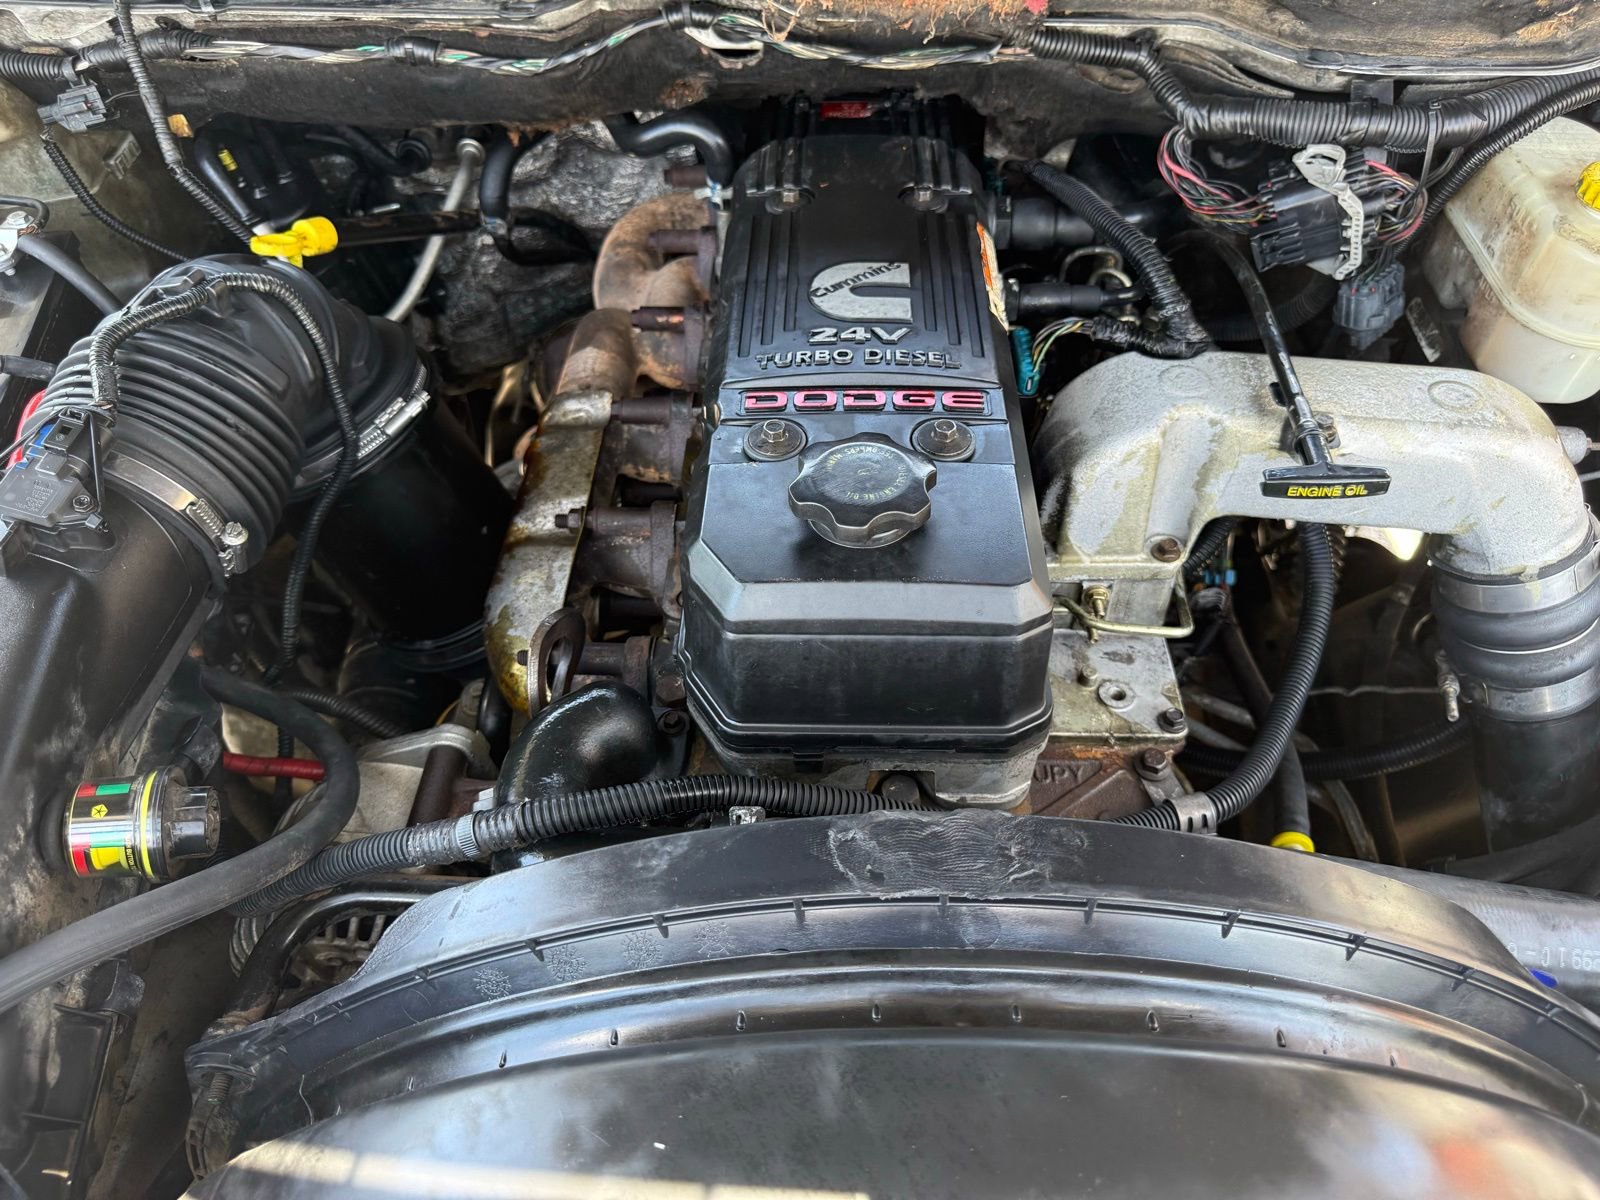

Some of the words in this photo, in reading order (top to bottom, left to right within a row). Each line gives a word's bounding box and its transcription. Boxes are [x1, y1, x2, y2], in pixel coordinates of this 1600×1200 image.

[810, 261, 901, 298] Cummins
[808, 327, 912, 346] 24V
[756, 349, 854, 369] TURBO
[864, 348, 961, 369] DIESEL
[744, 390, 985, 412] DODGE
[1287, 485, 1343, 497] ENGINE
[1345, 484, 1368, 496] OIL
[126, 848, 135, 865] BUTTON
